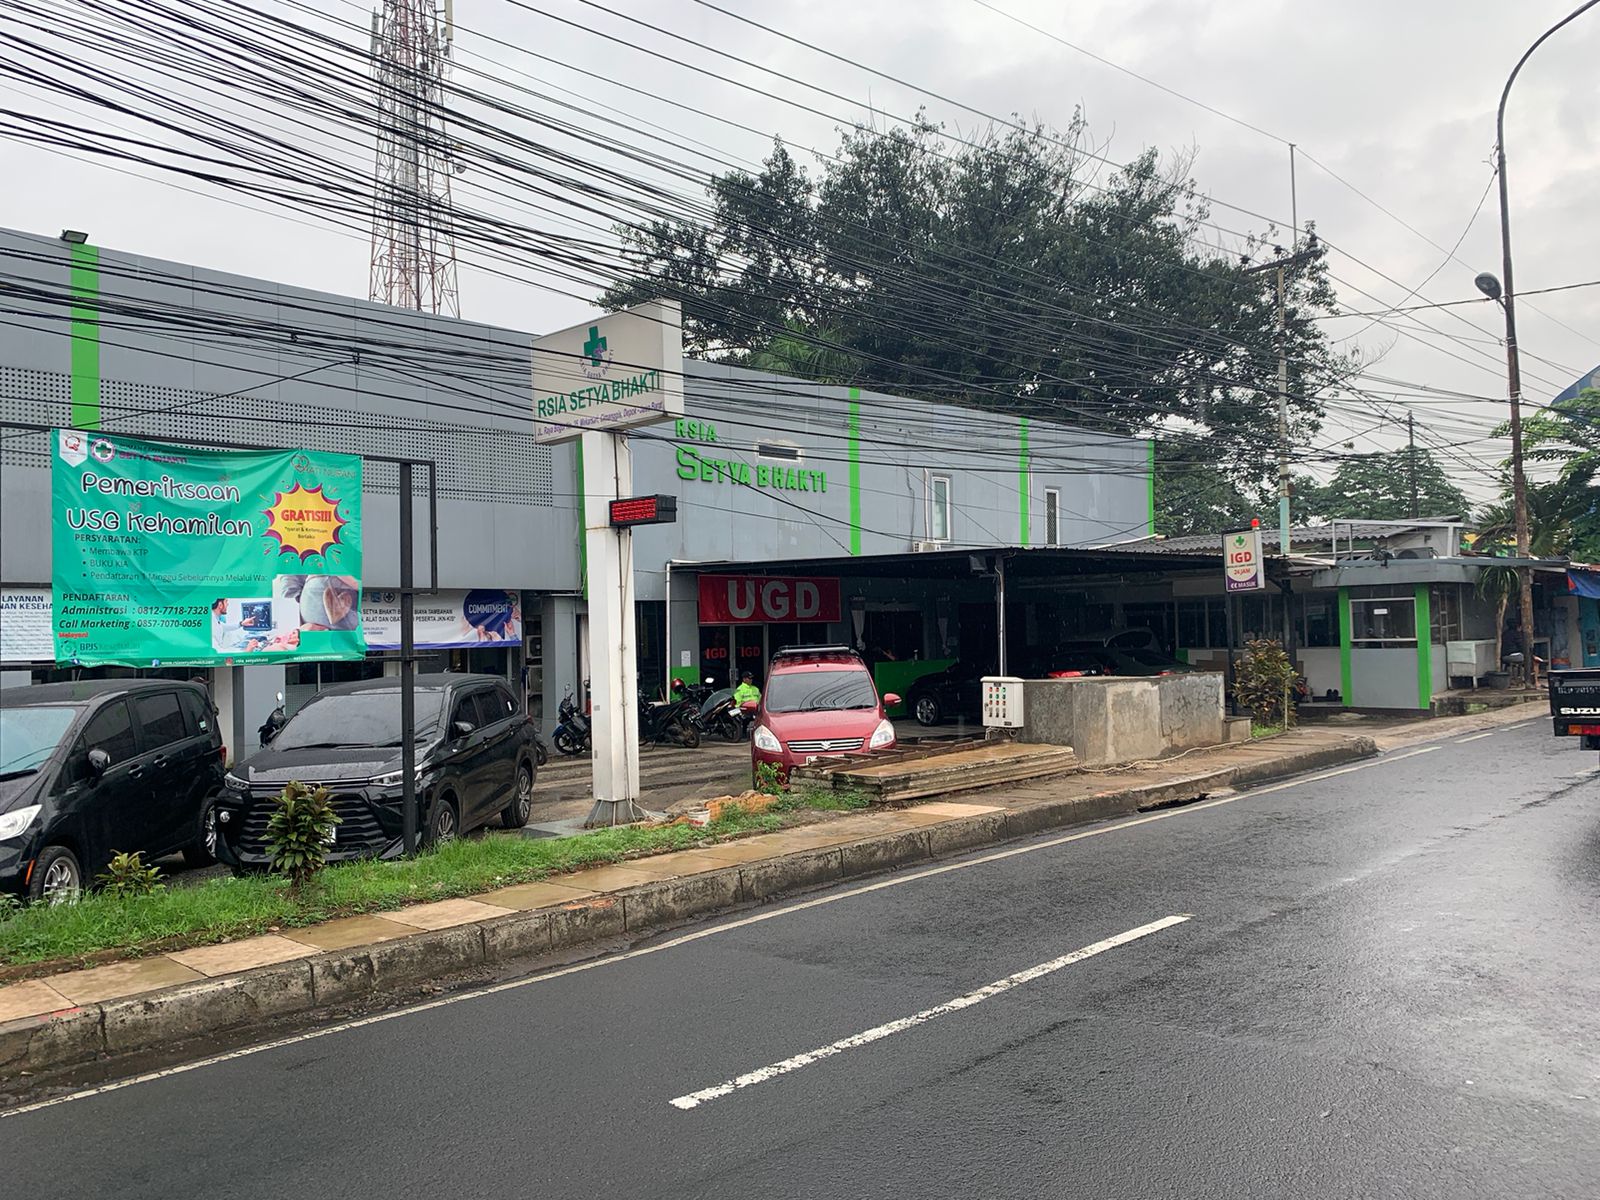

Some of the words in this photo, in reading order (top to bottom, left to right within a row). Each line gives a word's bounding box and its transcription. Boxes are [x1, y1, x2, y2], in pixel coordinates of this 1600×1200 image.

[538, 394, 567, 418] RSIA
[570, 383, 610, 411] SETYA
[612, 370, 661, 401] BHAKTI
[675, 417, 718, 442] RSIA
[676, 446, 751, 486] SETYA
[756, 464, 828, 493] BHAKTI
[82, 472, 240, 502] Pemeriksaan
[67, 508, 120, 531] USG
[127, 511, 253, 537] Kehamilan
[74, 533, 141, 544] PERSYARATAN:
[89, 547, 132, 556] Membawa
[133, 548, 149, 556] KTP
[1230, 551, 1252, 564] IGD
[90, 559, 113, 567] BUKU
[90, 571, 139, 580] Pendaftaran
[147, 573, 176, 583] Minggu
[179, 572, 224, 583] Sebelumnya
[62, 593, 130, 602] PENDAFTARAN
[727, 580, 820, 619] UGD
[61, 605, 127, 615] Administrasi
[137, 606, 208, 615] 0812-7718-7328
[59, 620, 78, 628] Call
[80, 620, 130, 630] Marketing
[137, 619, 202, 628] 0857-7070-0056
[80, 643, 98, 651] BPJS
[741, 646, 761, 657] IGD
[705, 647, 728, 660] IGD
